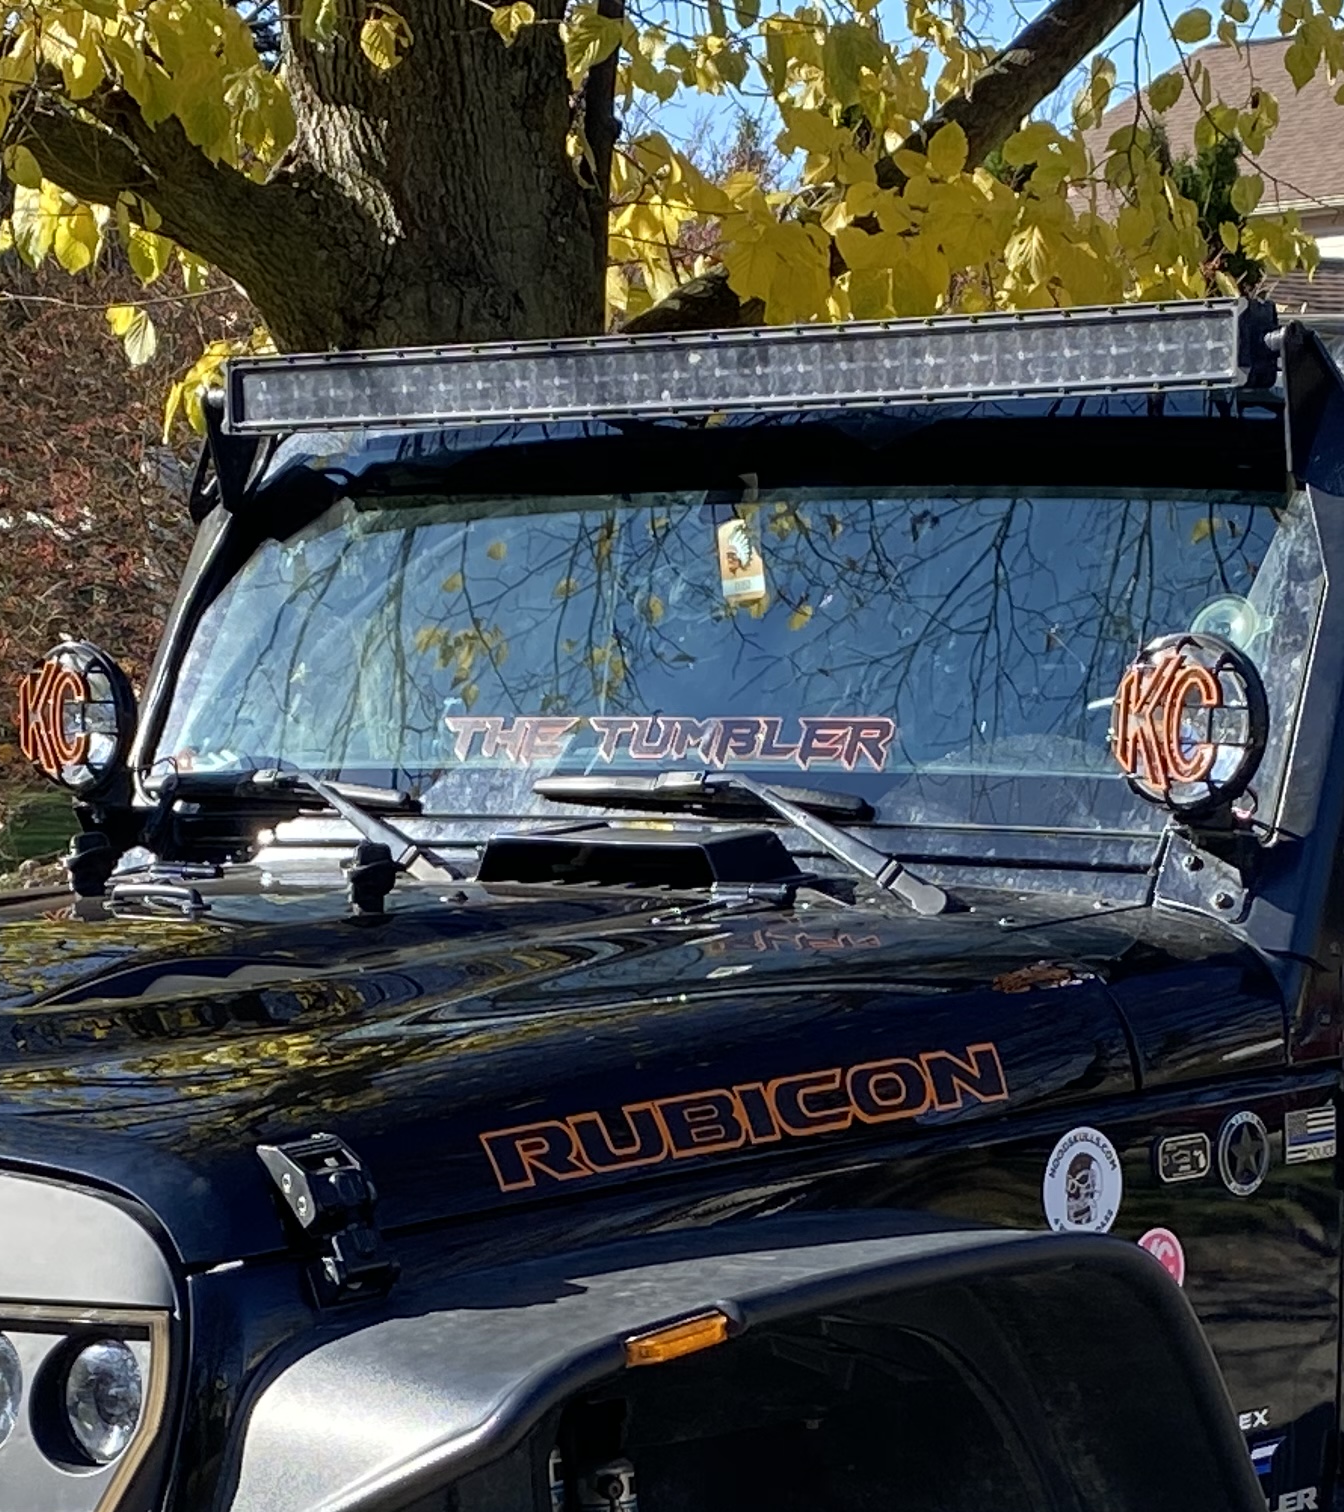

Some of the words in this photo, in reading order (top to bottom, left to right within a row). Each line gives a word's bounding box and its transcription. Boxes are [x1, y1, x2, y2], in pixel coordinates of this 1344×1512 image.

[19, 656, 85, 775] KC
[445, 716, 580, 766] THE
[589, 716, 896, 772] TUMBLER
[1116, 653, 1218, 790] KC
[480, 1043, 1010, 1192] RUBICON
